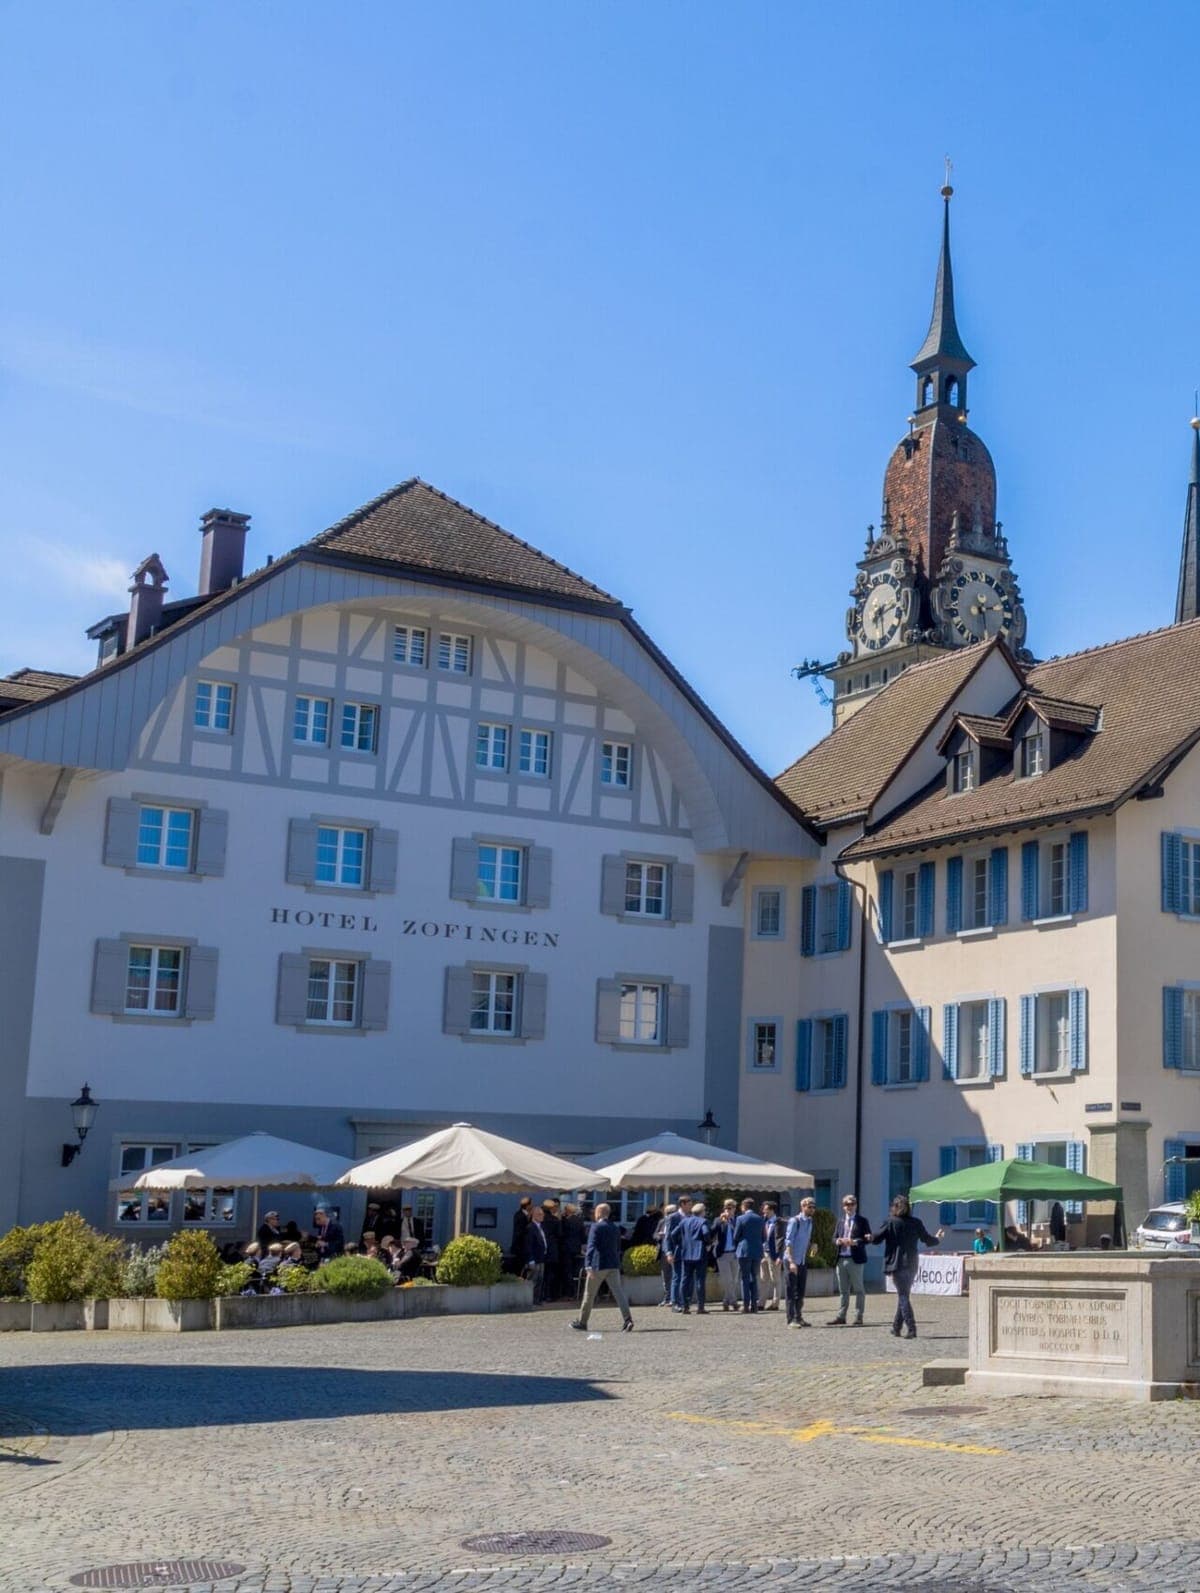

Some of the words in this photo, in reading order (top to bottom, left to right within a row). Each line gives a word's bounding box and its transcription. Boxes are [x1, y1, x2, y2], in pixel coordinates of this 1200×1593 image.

[271, 907, 378, 932] HOTEL
[401, 918, 561, 948] ZOFINGEN
[913, 1266, 958, 1284] leco.ch
